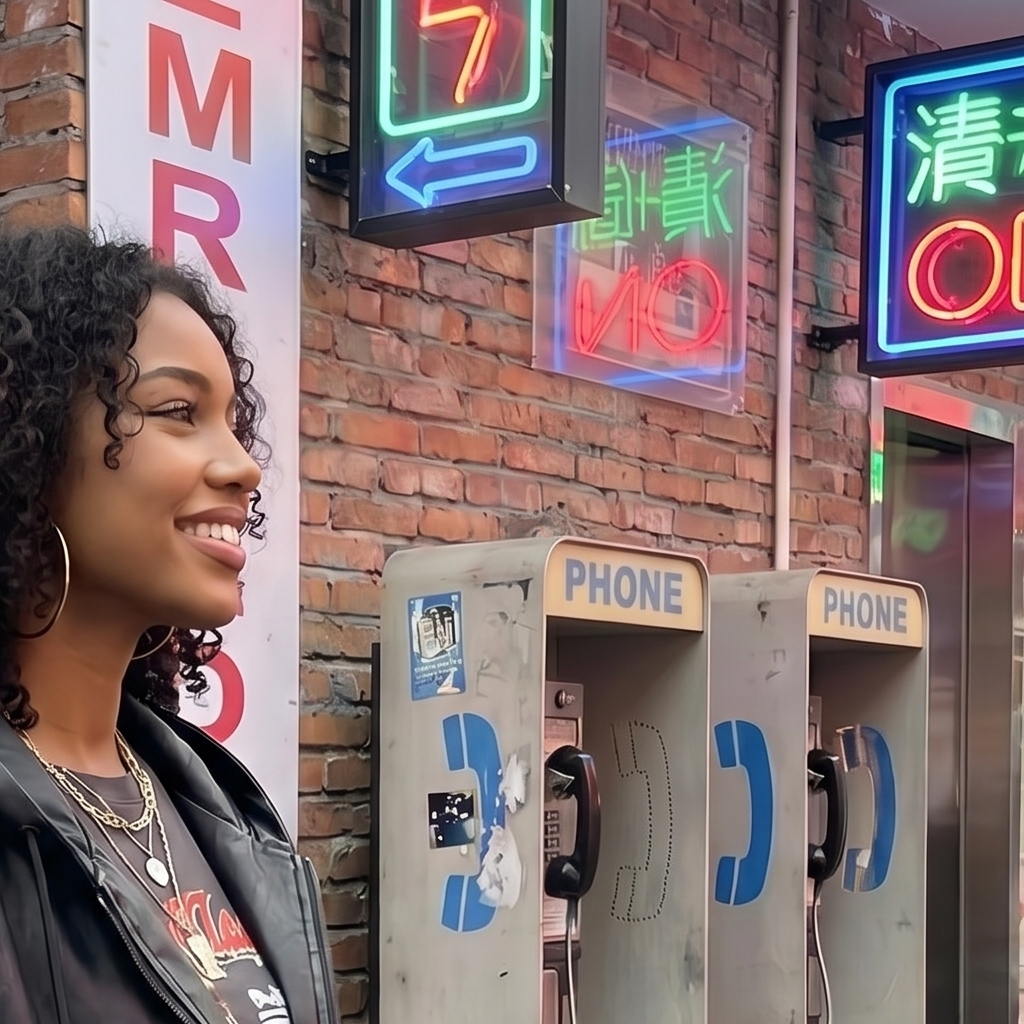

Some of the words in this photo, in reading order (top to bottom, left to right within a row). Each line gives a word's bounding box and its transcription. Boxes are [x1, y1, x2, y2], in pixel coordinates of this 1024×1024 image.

[148, 0, 251, 293] MR
[565, 557, 683, 615] PHONE
[824, 586, 907, 634] PHONE
